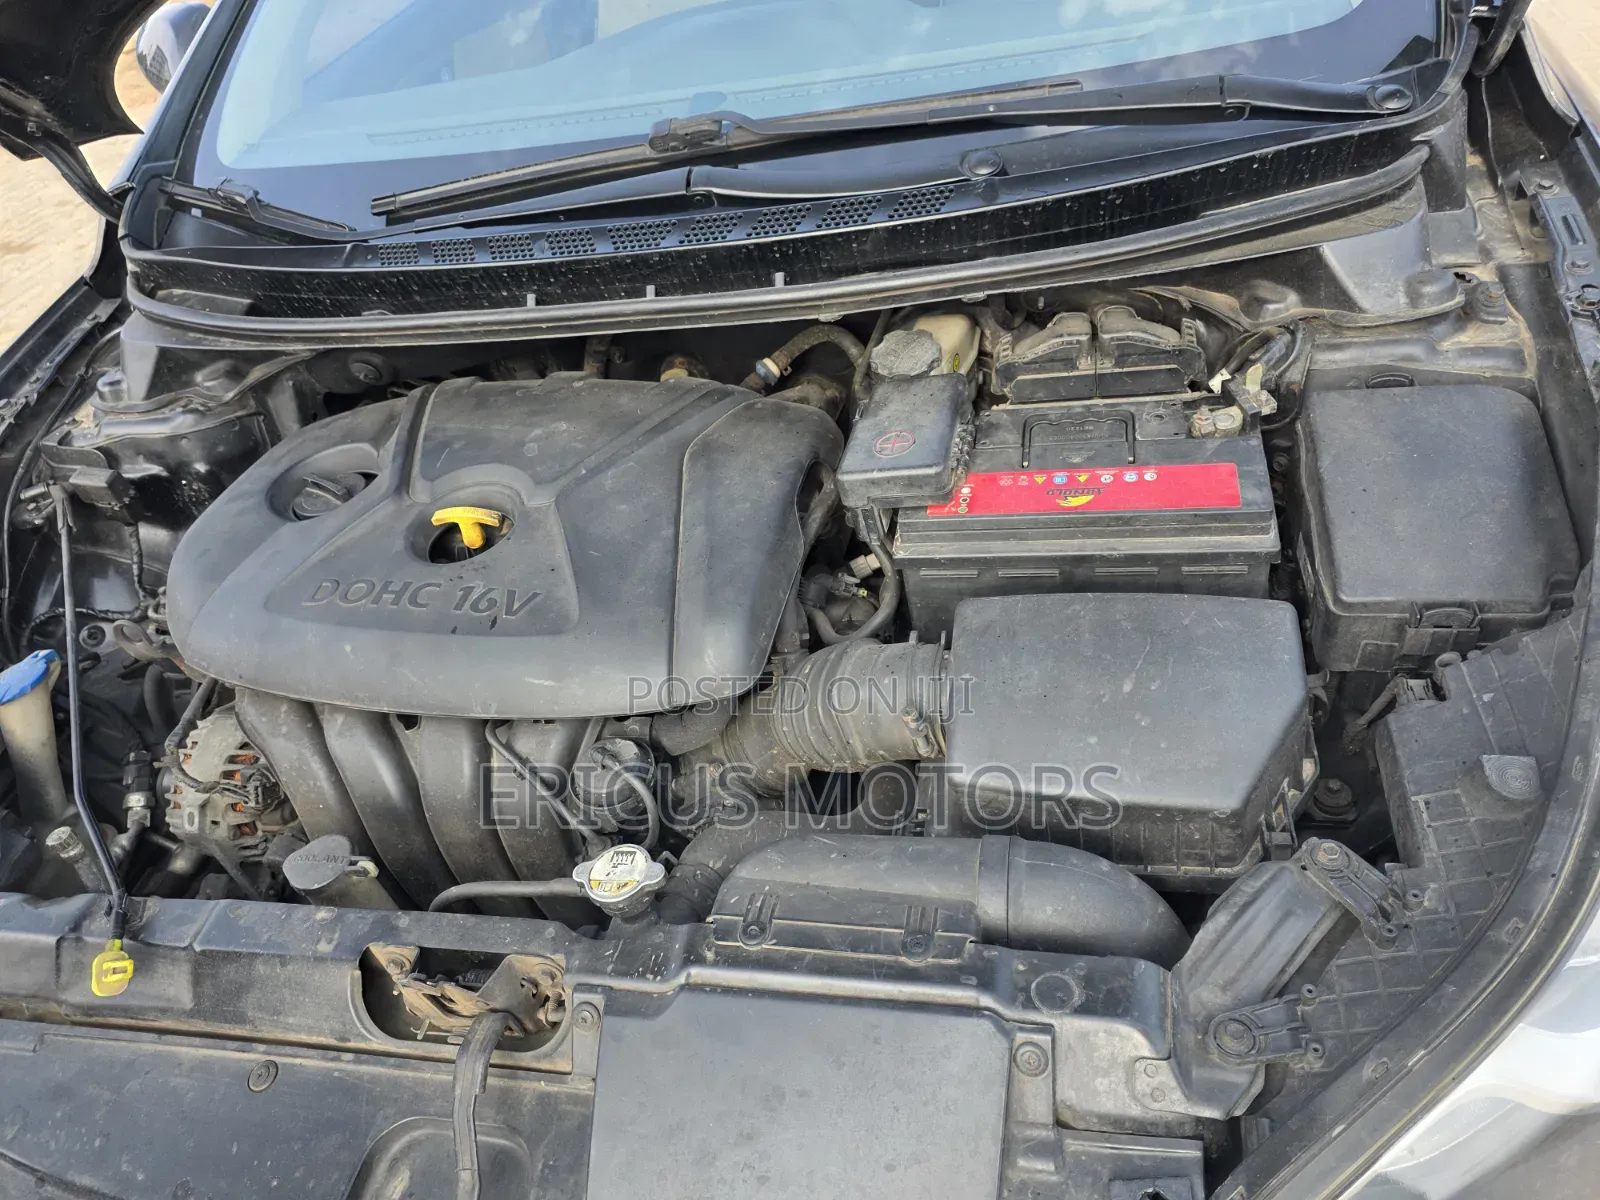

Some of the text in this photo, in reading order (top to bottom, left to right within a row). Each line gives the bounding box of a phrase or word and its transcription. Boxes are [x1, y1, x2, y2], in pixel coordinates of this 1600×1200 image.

[301, 578, 542, 618] DOHC 16V
[293, 854, 348, 865] COOLANT
